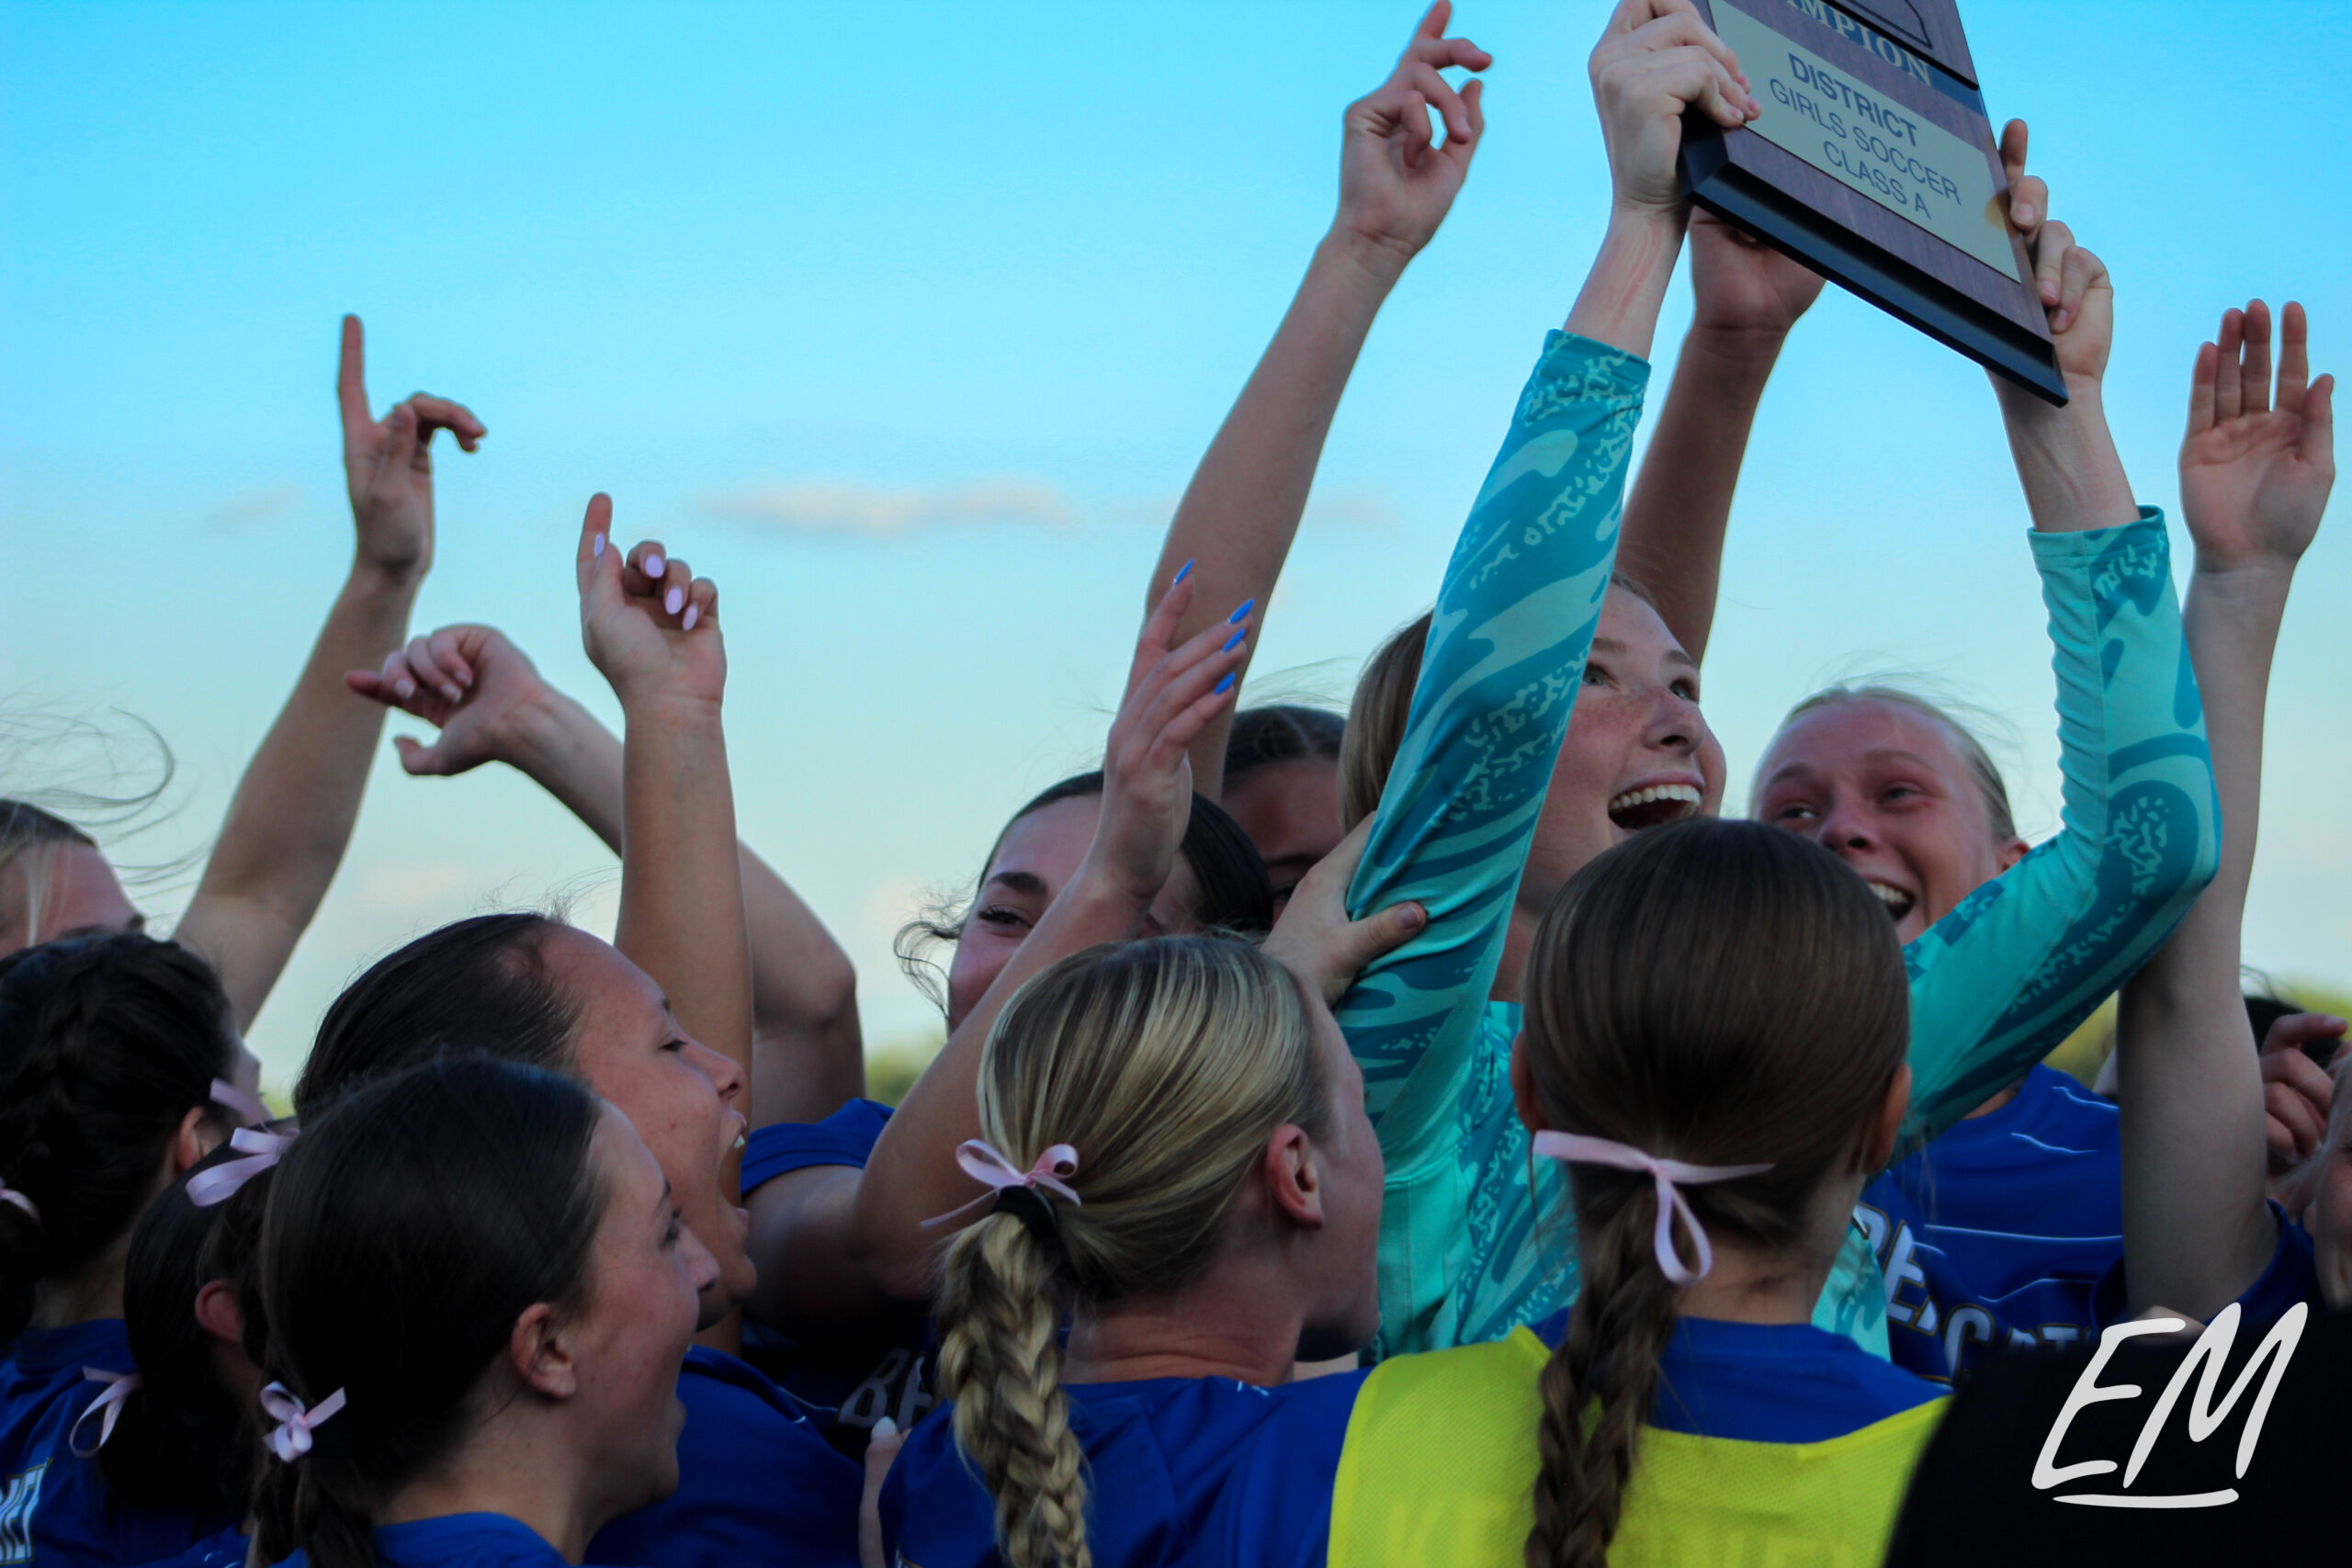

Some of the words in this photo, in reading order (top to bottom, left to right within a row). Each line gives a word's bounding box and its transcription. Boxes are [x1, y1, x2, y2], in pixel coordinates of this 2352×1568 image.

[1786, 0, 1931, 85] MPION
[1769, 77, 1847, 140] GIRLS
[1852, 129, 1962, 206] SOCCER
[1788, 52, 1917, 147] DISTRICT
[1823, 141, 1908, 205] CLASS
[1915, 193, 1931, 220] A
